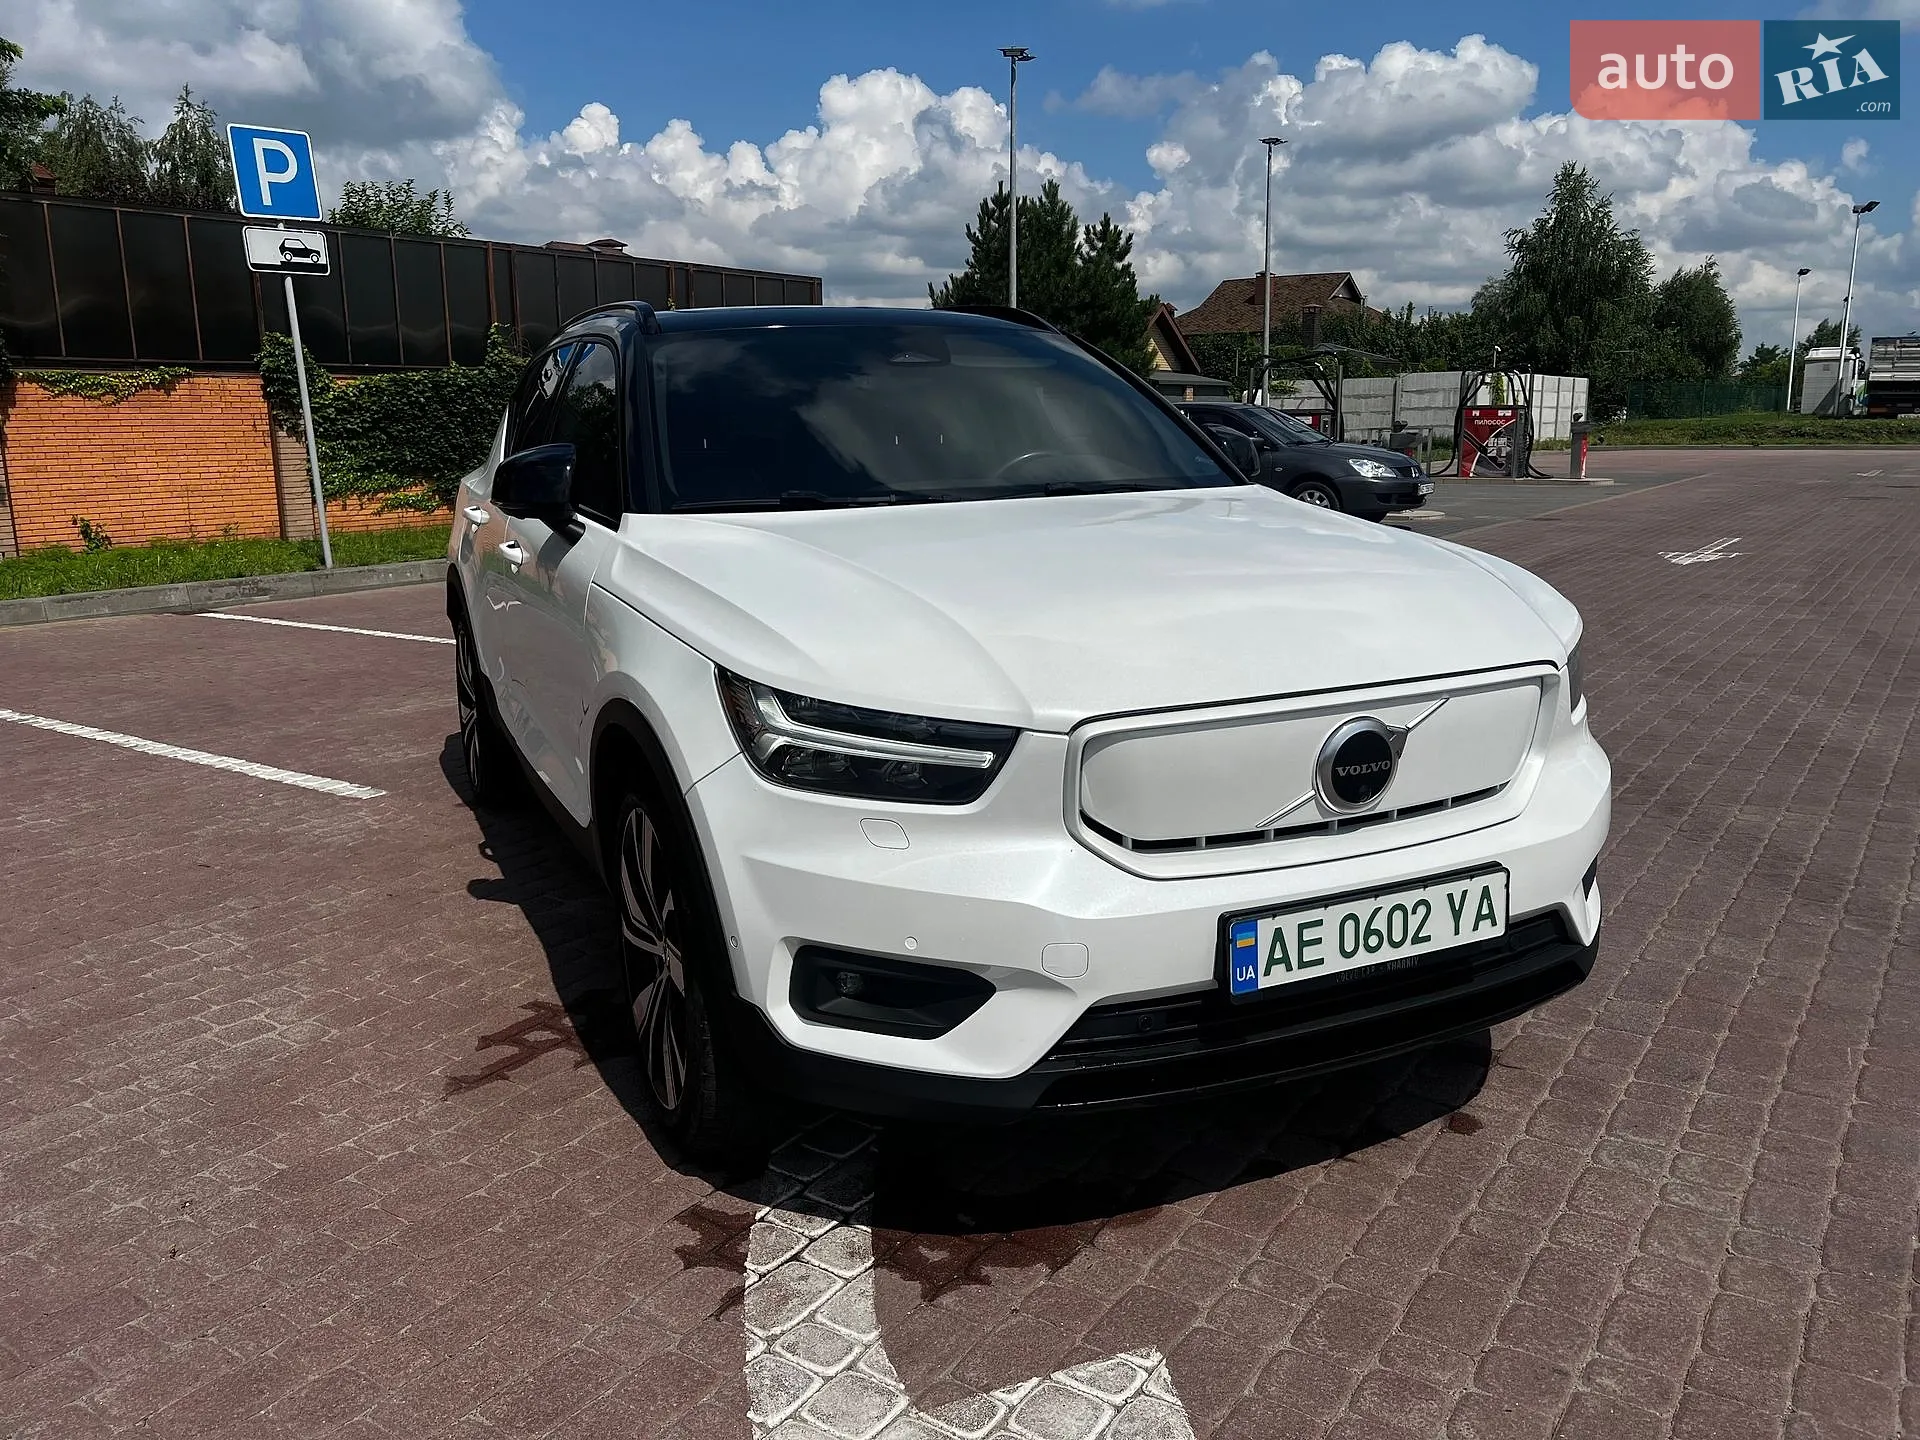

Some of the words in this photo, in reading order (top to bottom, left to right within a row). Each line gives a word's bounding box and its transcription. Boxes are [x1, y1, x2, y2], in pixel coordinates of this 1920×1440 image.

[253, 137, 298, 206] P
[1335, 760, 1391, 777] VOLVO
[1263, 919, 1325, 977] AE
[1338, 898, 1432, 960] 0602
[1446, 885, 1498, 936] YA
[1236, 965, 1256, 982] UA
